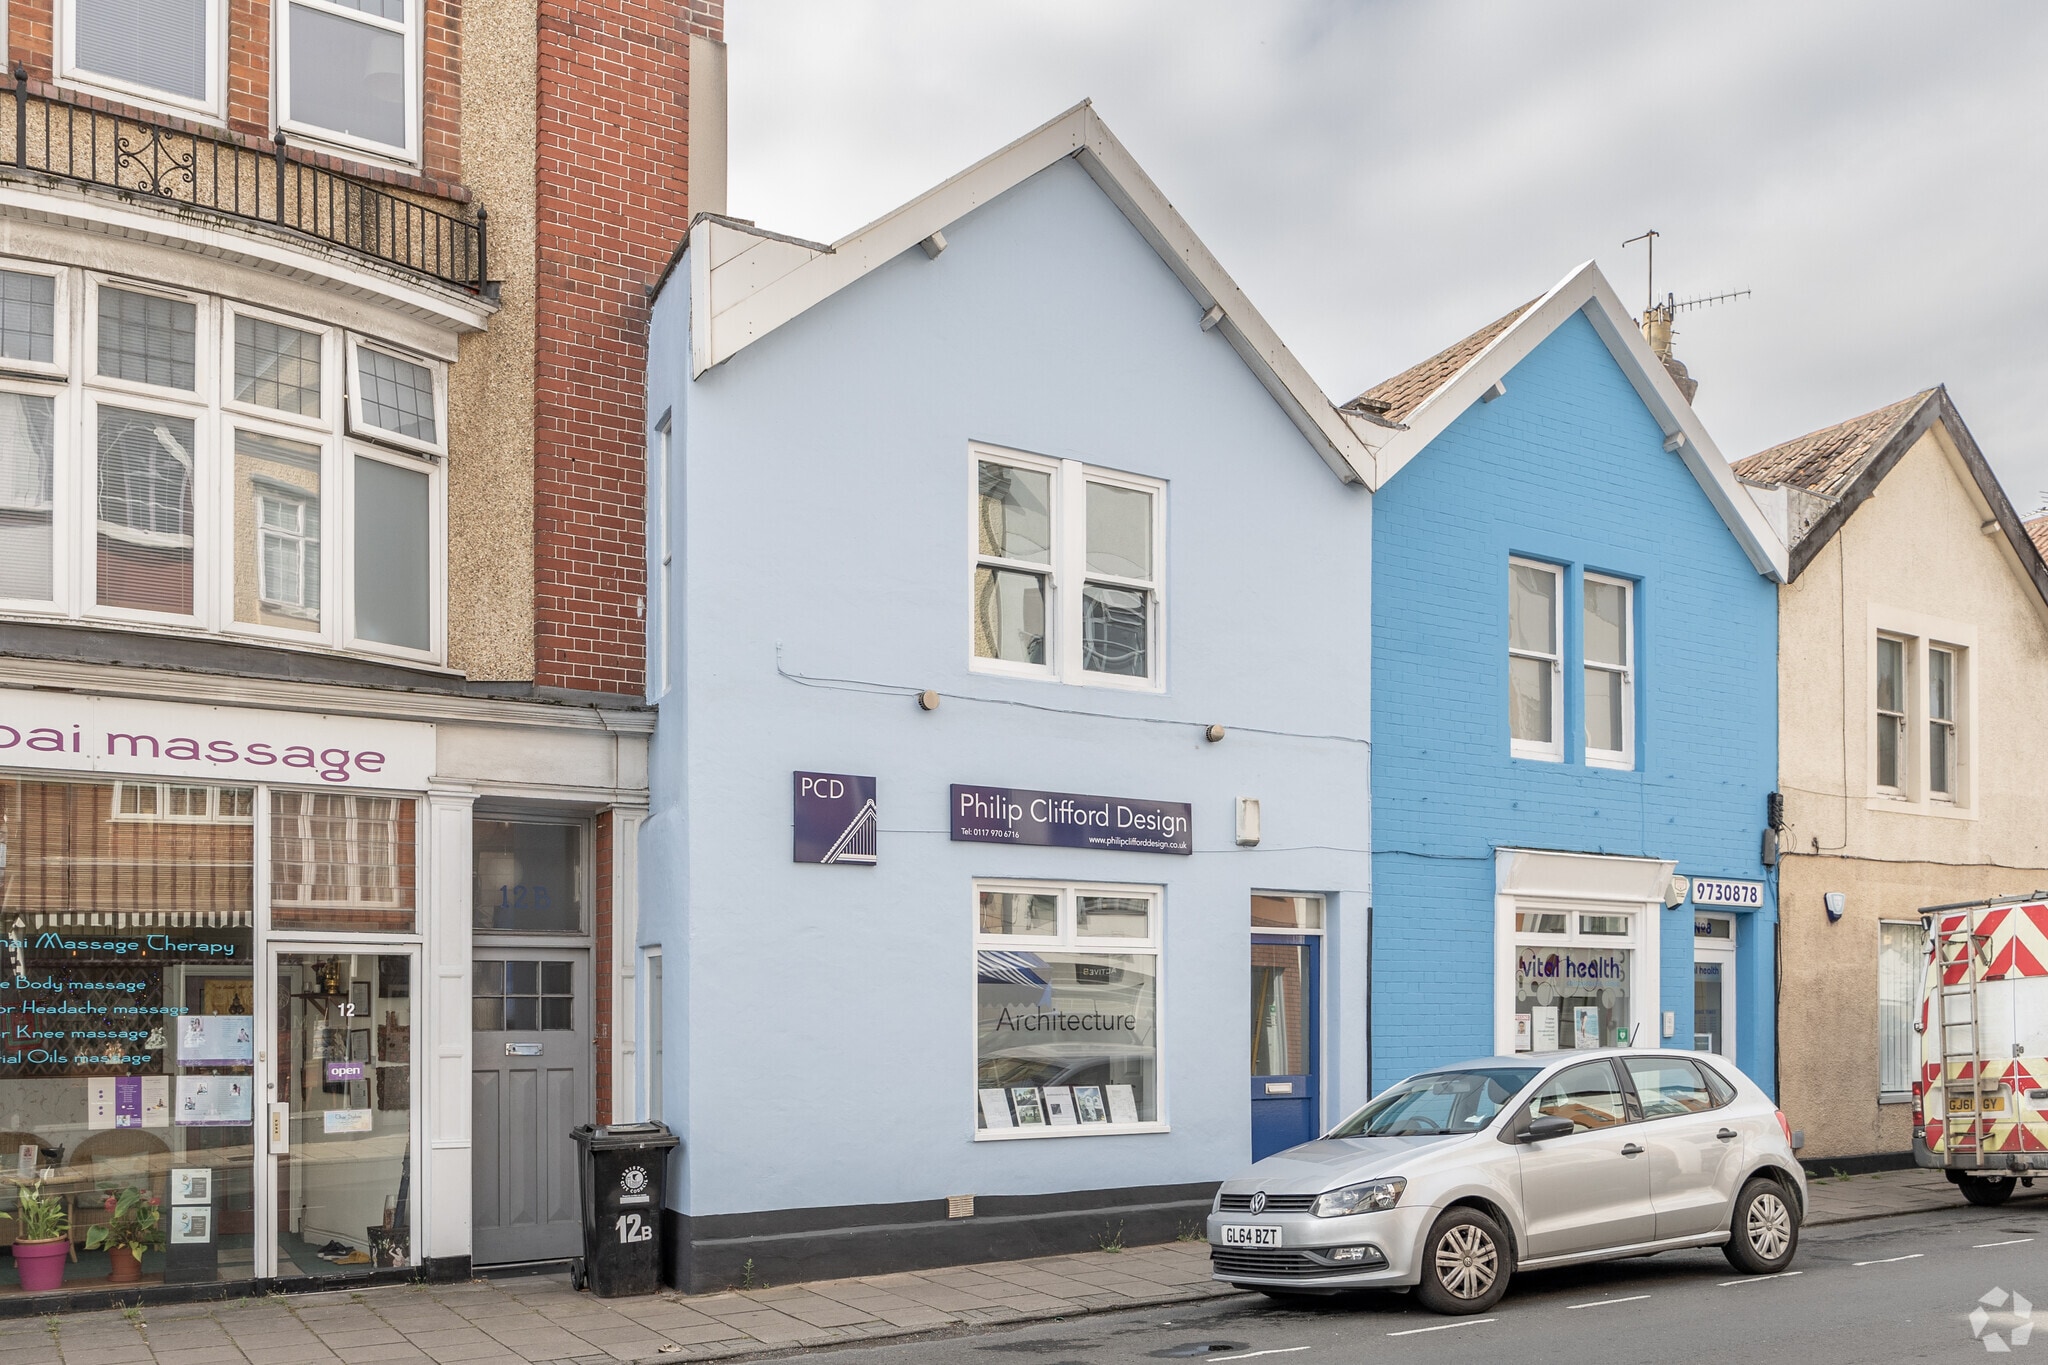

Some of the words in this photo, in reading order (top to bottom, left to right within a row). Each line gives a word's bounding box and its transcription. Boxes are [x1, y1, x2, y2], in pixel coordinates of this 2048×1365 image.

[107, 733, 386, 782] massage
[801, 777, 844, 799] PCD
[961, 793, 1023, 829] Philip
[1030, 798, 1109, 827] Clifford
[1117, 805, 1187, 838] Design
[961, 827, 973, 836] Tel:
[973, 828, 989, 837] 0117
[990, 829, 1003, 838] 970
[1003, 830, 1020, 839] 6716
[1088, 836, 1188, 850] www.philipclifforddesign.co.uk
[500, 884, 551, 910] 12B
[1697, 882, 1758, 903] 9730878
[35, 932, 139, 954] Massage
[147, 934, 234, 956] Therapy
[1522, 954, 1560, 978] vital
[1566, 955, 1620, 979] health
[16, 975, 63, 993] Body
[69, 980, 146, 992] massage
[22, 1000, 108, 1014] Headache
[113, 1005, 189, 1017] massage
[338, 1003, 356, 1016] 12
[996, 1006, 1136, 1031] Architecture
[17, 1025, 65, 1039] Knee
[71, 1030, 148, 1042] massage
[27, 1049, 68, 1063] Oils
[74, 1054, 151, 1066] massage
[331, 1066, 360, 1077] open
[1949, 1099, 1973, 1111] GJ61
[1983, 1098, 1997, 1110] GY
[622, 1166, 647, 1176] BRISTOL
[615, 1213, 653, 1244] 12B
[1226, 1228, 1252, 1244] GL64
[1255, 1228, 1277, 1245] BZT
